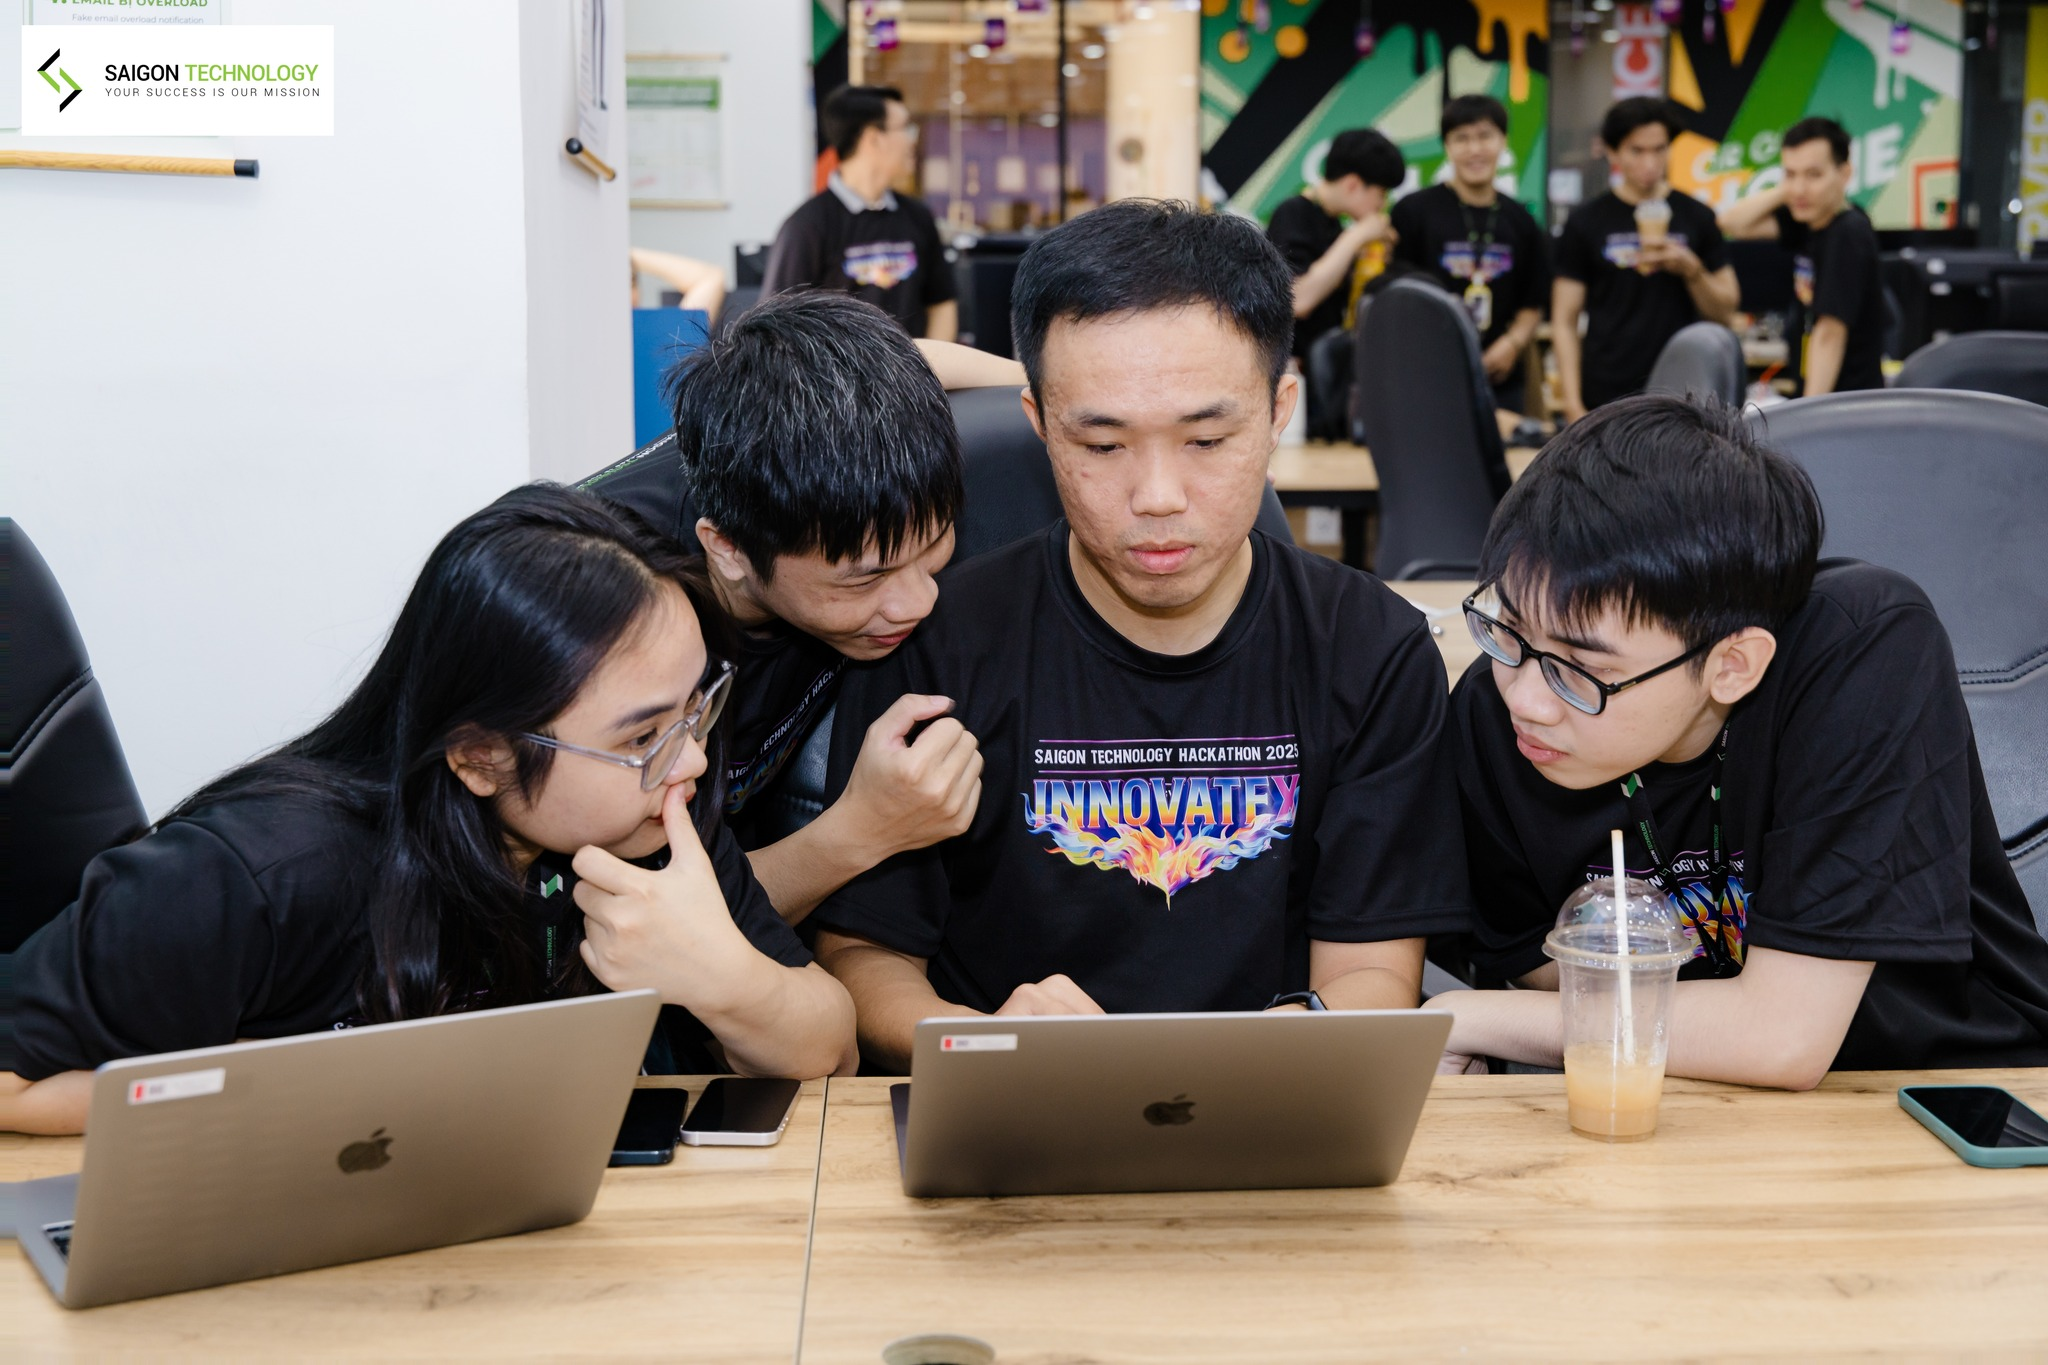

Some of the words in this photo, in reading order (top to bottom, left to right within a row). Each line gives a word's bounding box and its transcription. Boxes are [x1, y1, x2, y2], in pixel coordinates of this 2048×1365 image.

[72, 13, 93, 22] Fake
[94, 14, 118, 23] email
[120, 15, 157, 24] overload
[158, 16, 204, 25] notification
[1034, 749, 1086, 764] SAIGON
[1091, 748, 1173, 764] TECHNOLOGY
[1178, 746, 1262, 762] HACKATHON
[1265, 743, 1299, 760] 2025
[1033, 774, 1300, 828] INNOVATEX
